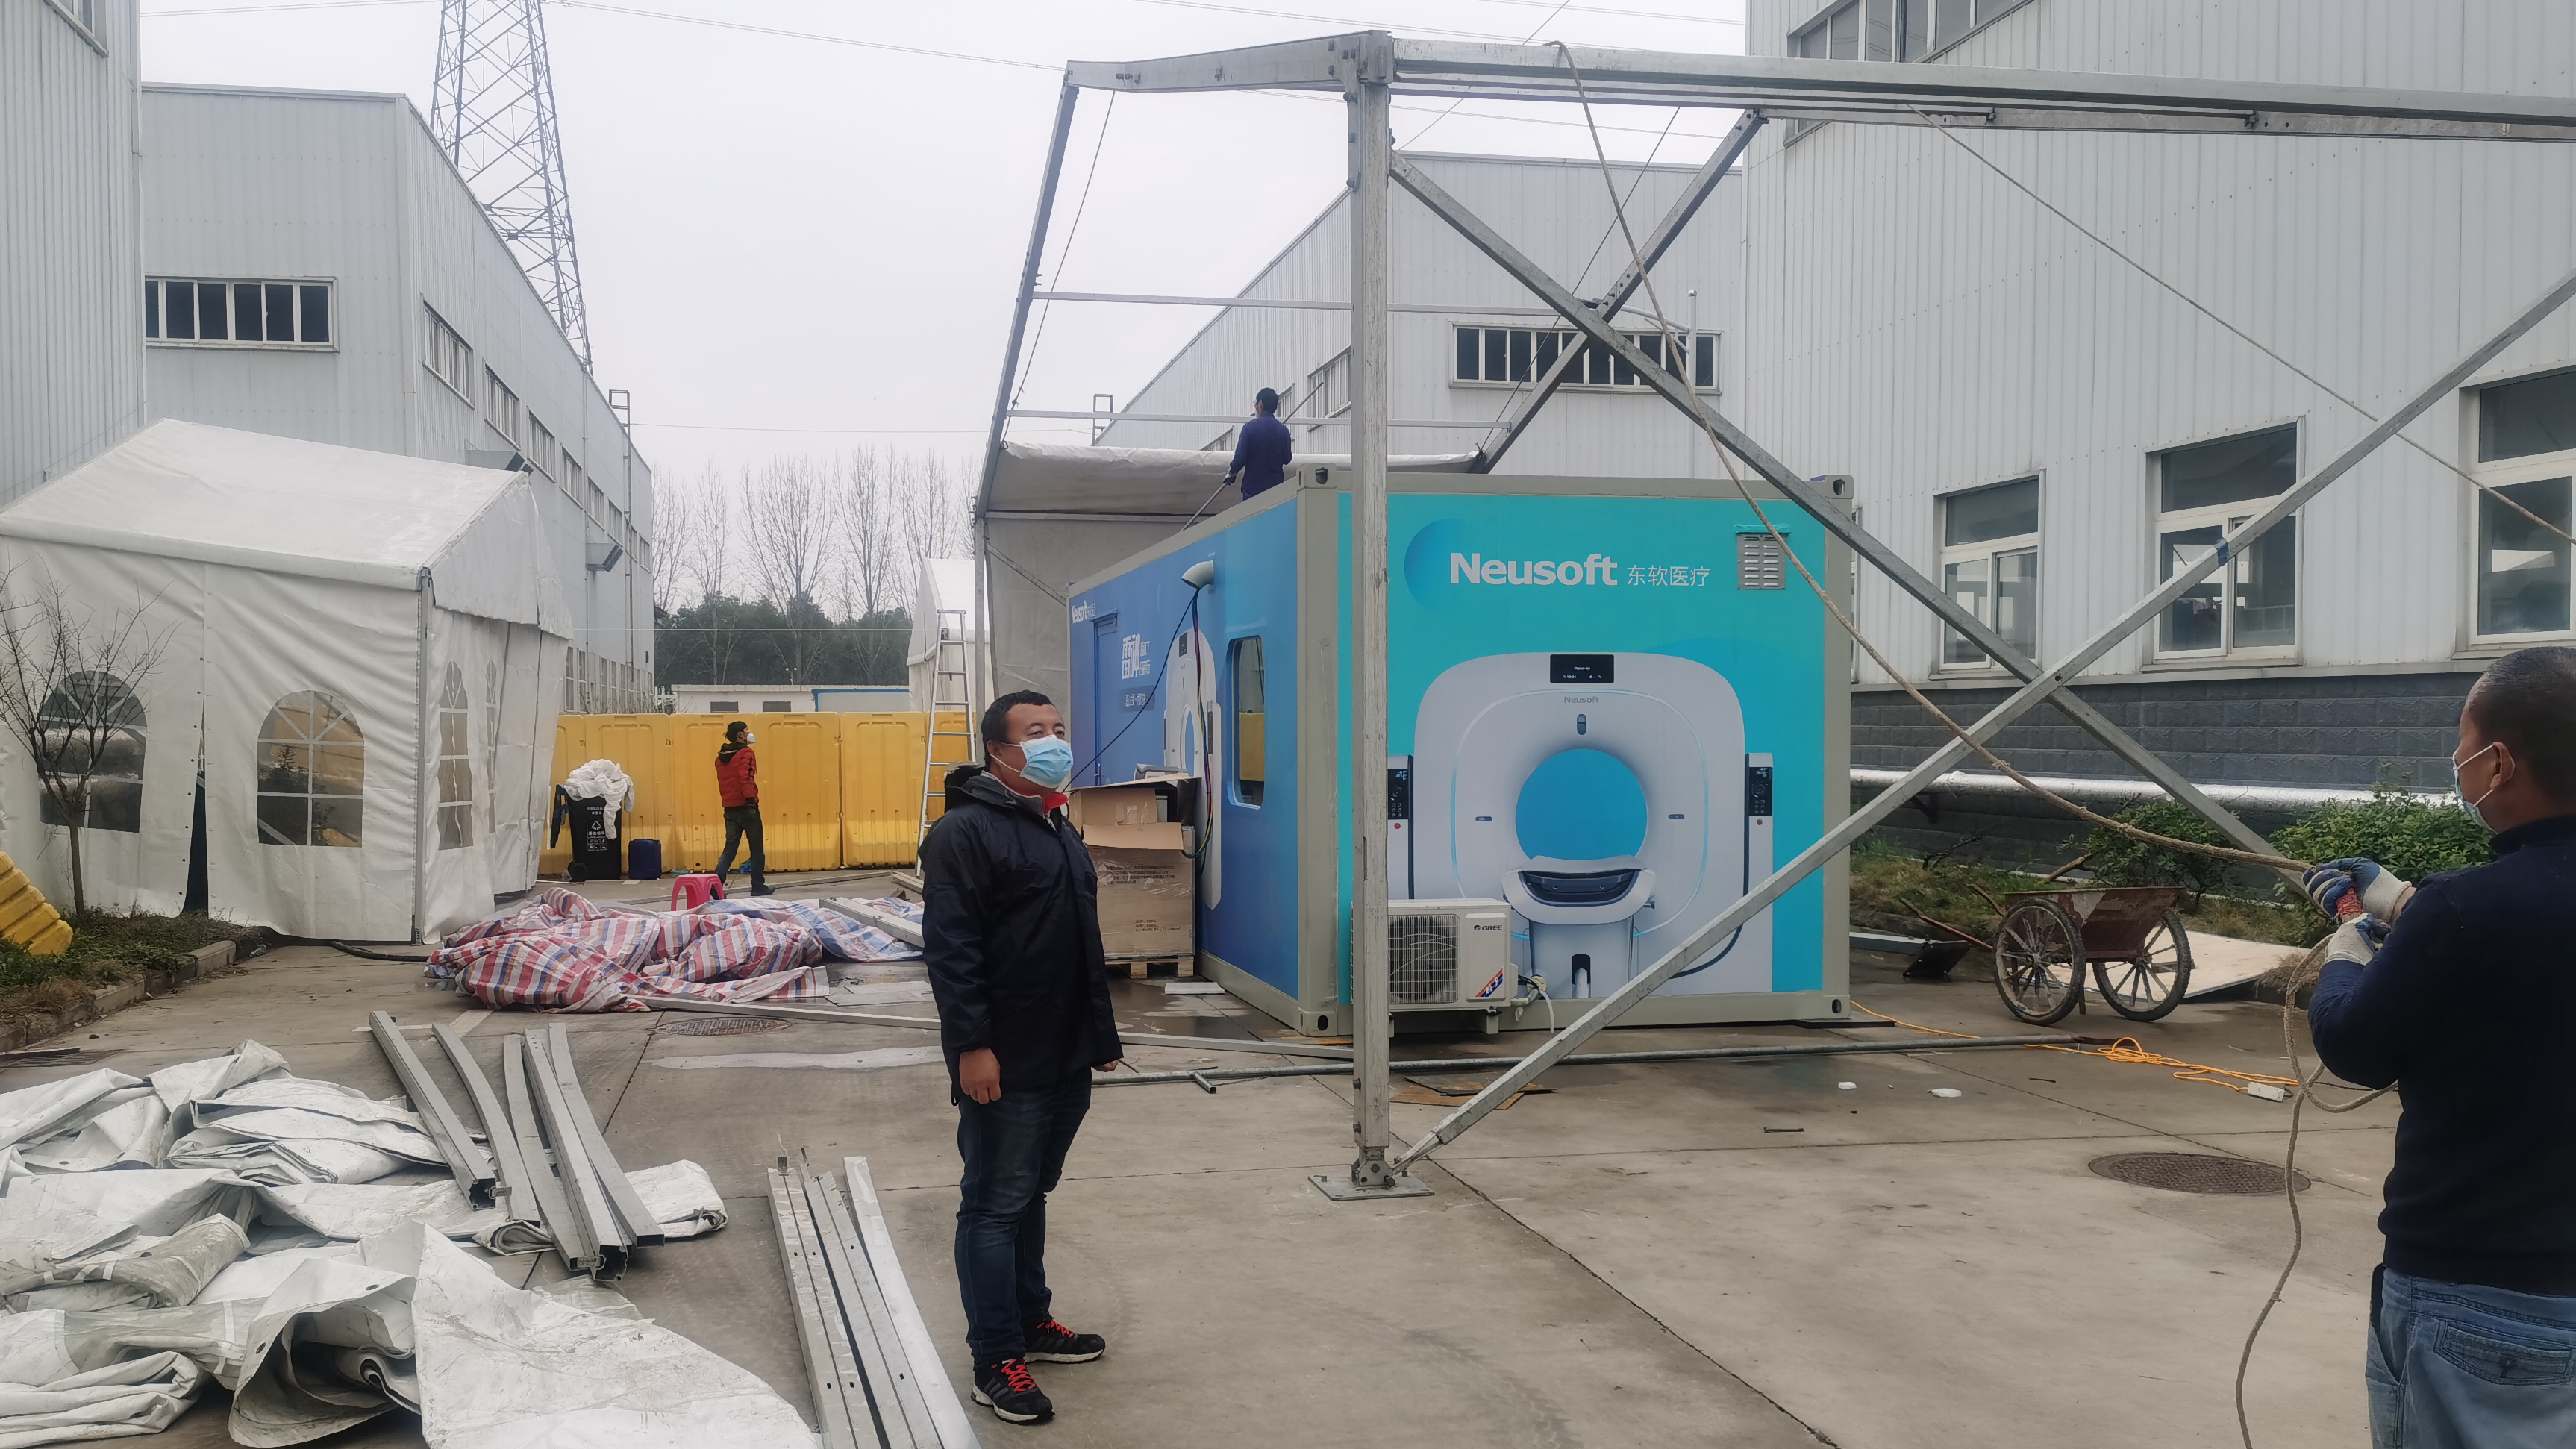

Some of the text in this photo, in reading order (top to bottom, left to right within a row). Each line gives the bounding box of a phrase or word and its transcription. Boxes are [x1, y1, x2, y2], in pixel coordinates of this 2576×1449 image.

[1450, 552, 1711, 587] Neusoft 东软医疗
[1563, 695, 1600, 704] Neusoft
